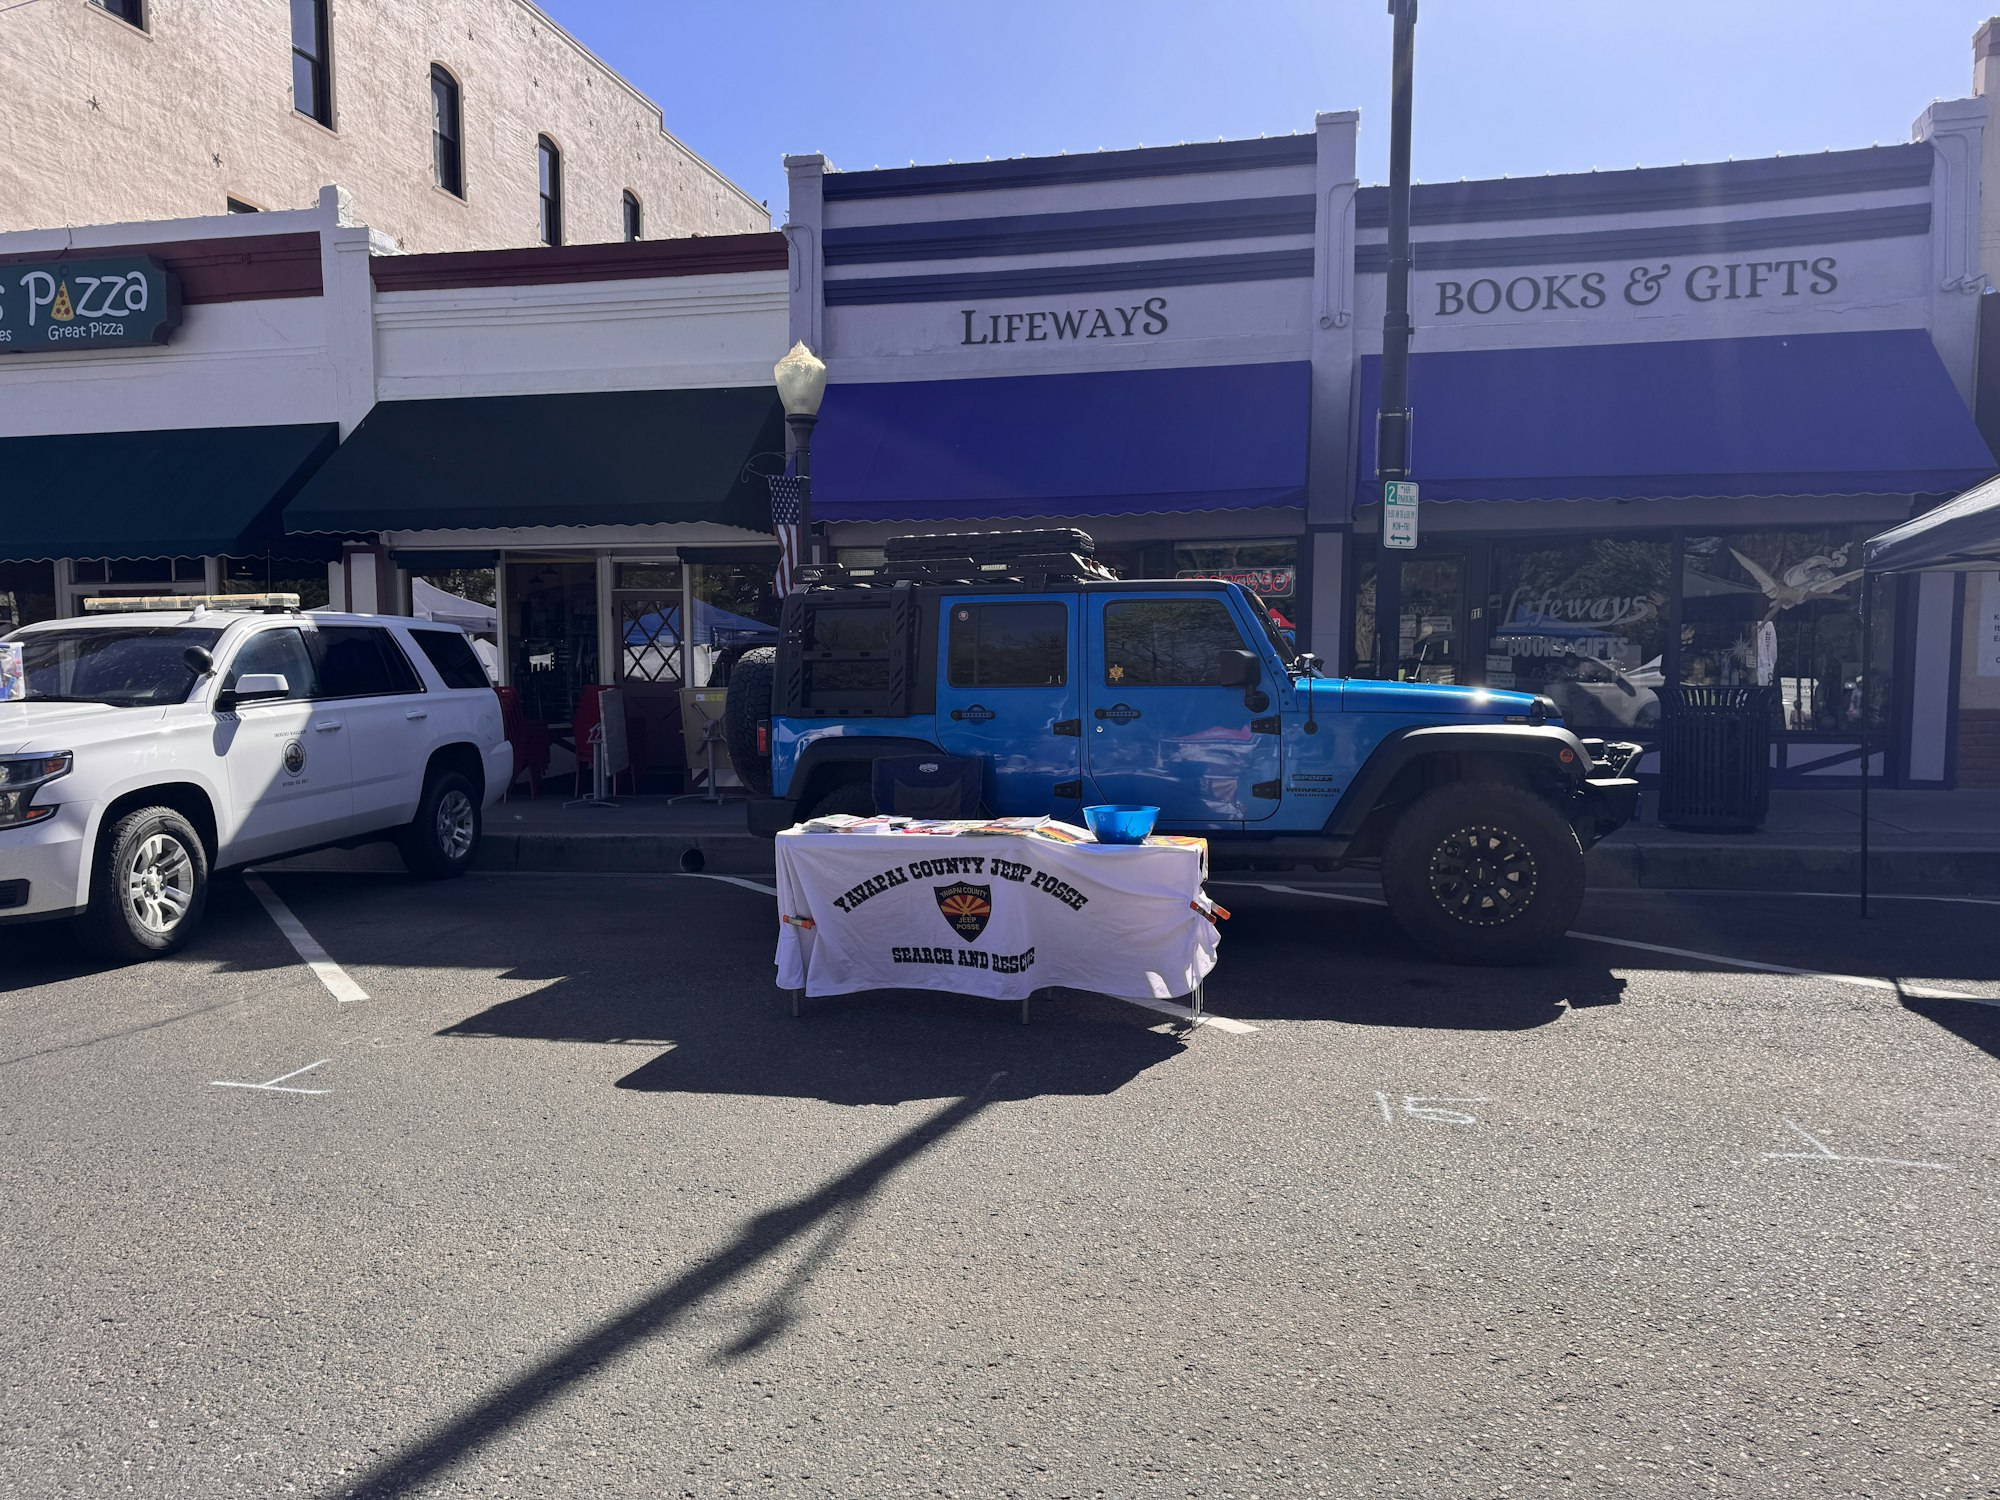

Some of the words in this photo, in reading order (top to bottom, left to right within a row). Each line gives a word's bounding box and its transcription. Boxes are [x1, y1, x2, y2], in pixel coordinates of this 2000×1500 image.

[1435, 272, 1607, 316] BOOKS
[1623, 264, 1672, 306] &
[1684, 257, 1839, 303] GIFTS
[48, 325, 87, 341] Great
[89, 322, 124, 338] Pizza
[961, 297, 1168, 345] LIFEWAYS
[1388, 486, 1396, 502] 2
[1398, 495, 1416, 504] PARKING
[1403, 486, 1411, 494] HR
[1502, 586, 1650, 628] Lifeways
[1508, 637, 1566, 657] BOOKS
[1573, 637, 1629, 657] GIFTS
[833, 866, 909, 913] YAVAPAI
[908, 857, 985, 880] COUNTY
[990, 858, 1032, 883] JEEP
[1030, 871, 1089, 912] POSSE
[940, 887, 963, 898] YAVAPAI
[963, 887, 988, 898] COUNTY
[891, 947, 953, 964] SEARCH
[958, 950, 989, 969] AND
[1376, 1091, 1488, 1125] 15
